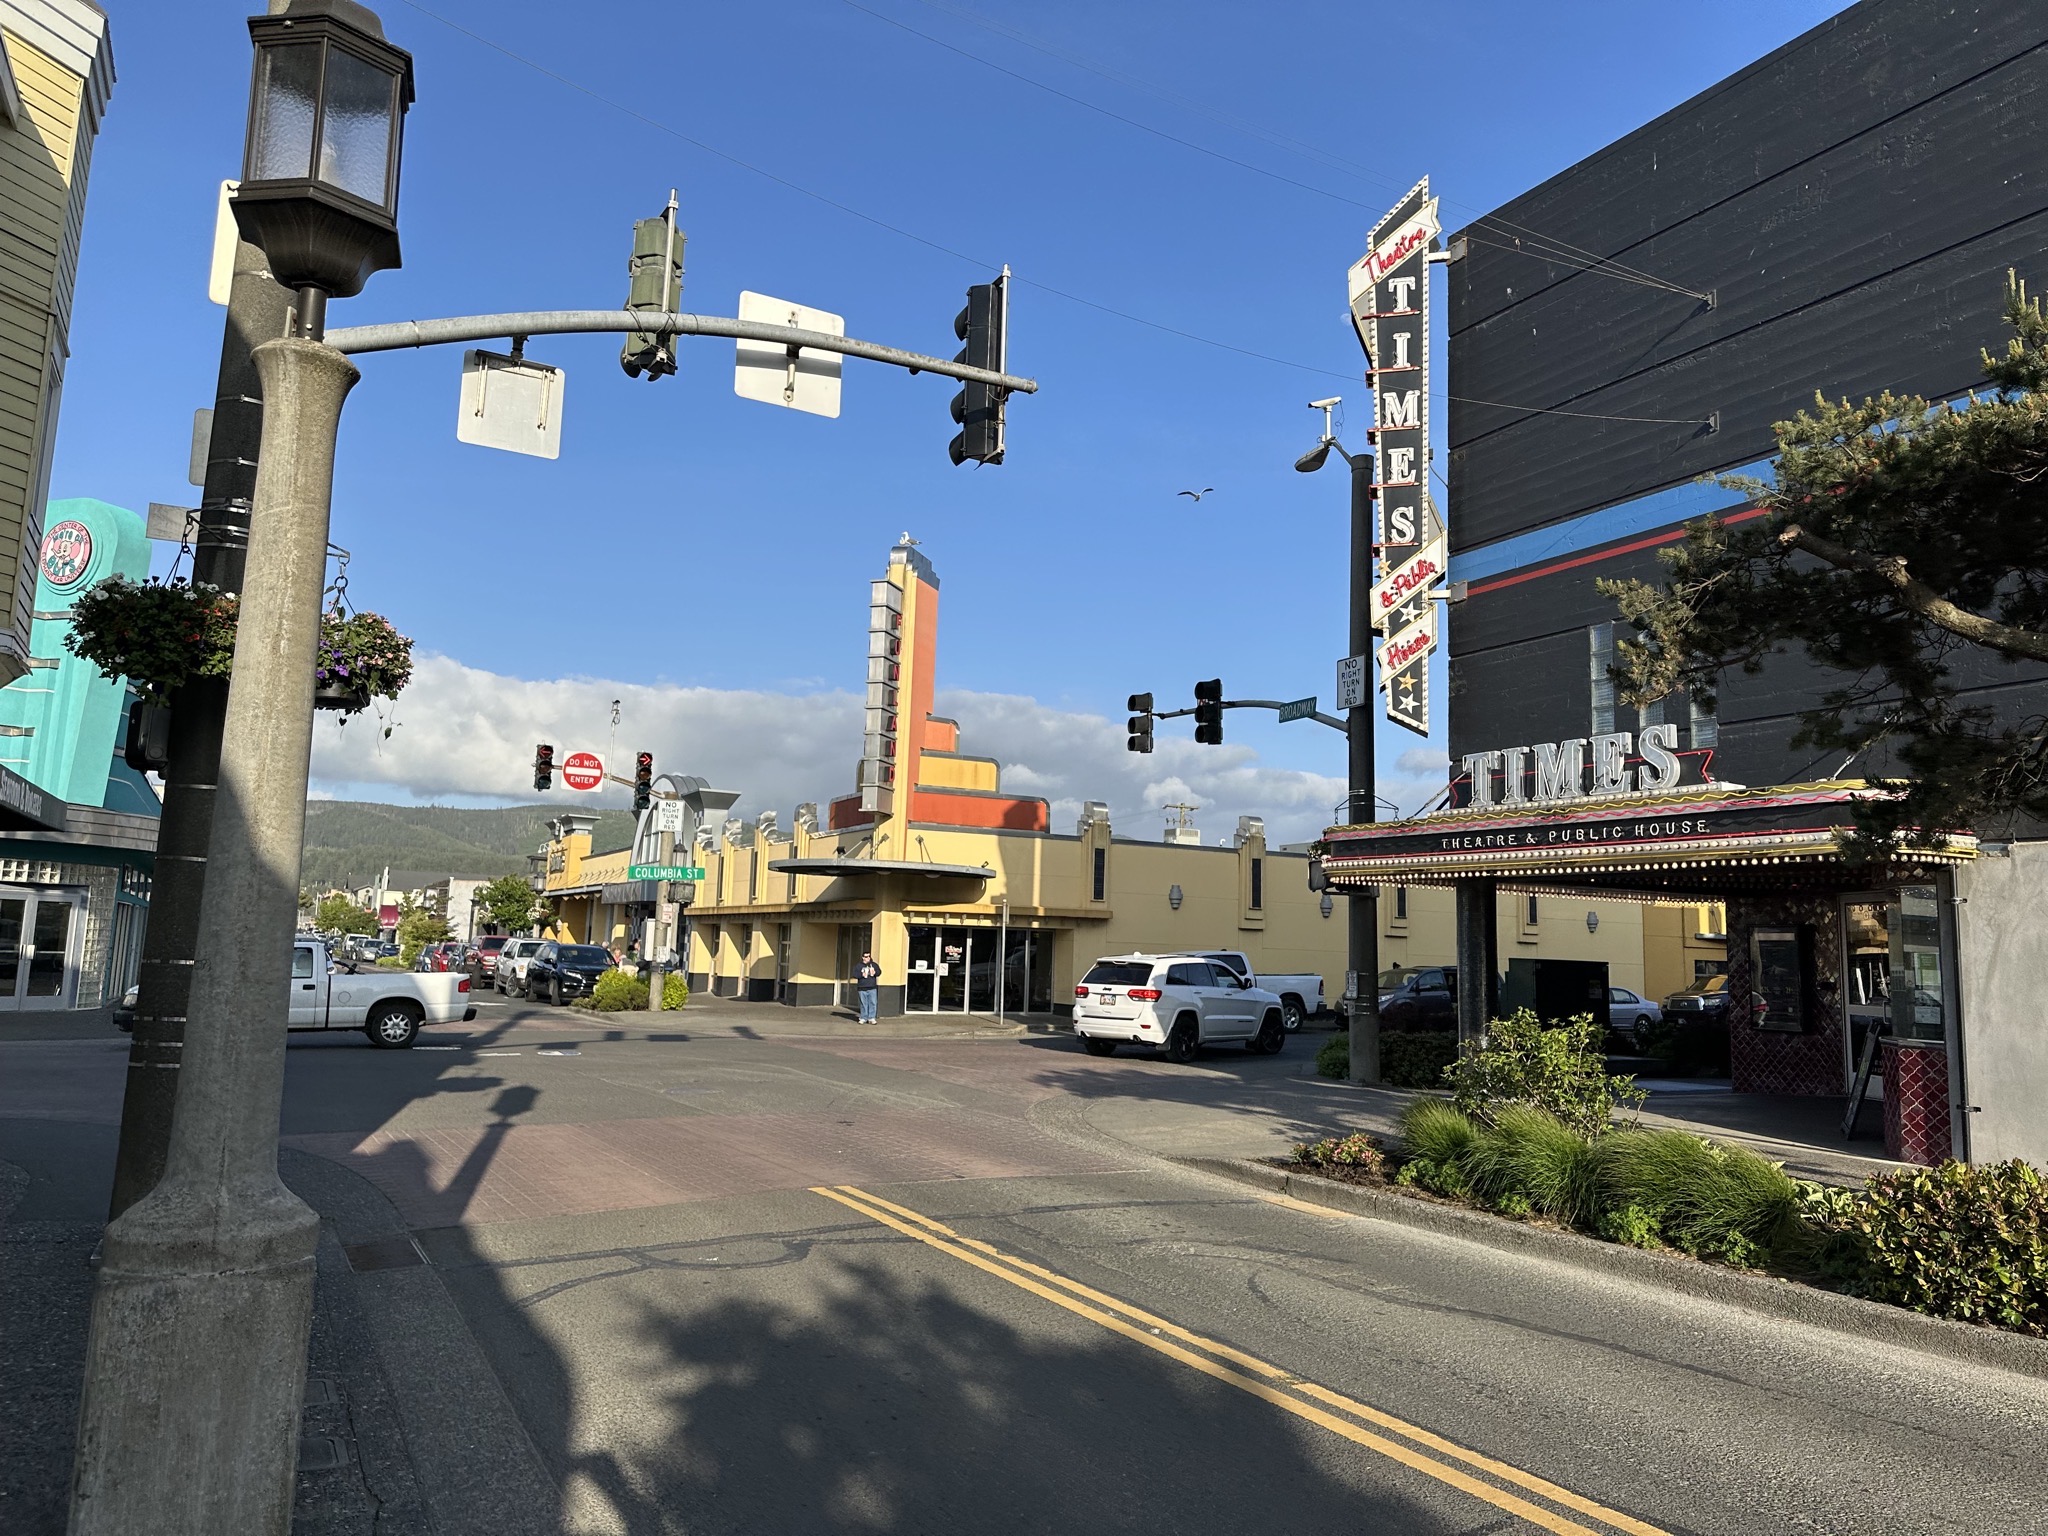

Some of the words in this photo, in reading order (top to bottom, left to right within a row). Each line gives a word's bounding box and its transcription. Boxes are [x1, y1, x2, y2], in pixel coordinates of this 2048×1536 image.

[1361, 227, 1427, 283] Theatre
[1382, 276, 1421, 543] TIMES
[1380, 590, 1397, 608] &
[1393, 559, 1436, 597] Public
[1387, 633, 1431, 670] House
[1344, 659, 1358, 670] NO
[1341, 668, 1361, 680] RIGHT
[1343, 678, 1360, 688] TURN
[886, 614, 902, 782] FUNLAND
[1344, 696, 1357, 706] RED
[1346, 688, 1356, 697] ON
[1280, 699, 1316, 721] BROADWAY
[569, 758, 580, 766] DO
[583, 760, 599, 768] NOT
[1462, 724, 1681, 808] TIMES
[570, 775, 595, 784] ENTER
[1441, 834, 1517, 849] THEATRE
[1526, 833, 1538, 844] &
[1549, 826, 1622, 843] PUBLIC
[1635, 820, 1710, 837] HOUSE
[635, 867, 683, 878] COLUMBIA
[687, 868, 699, 879] ST
